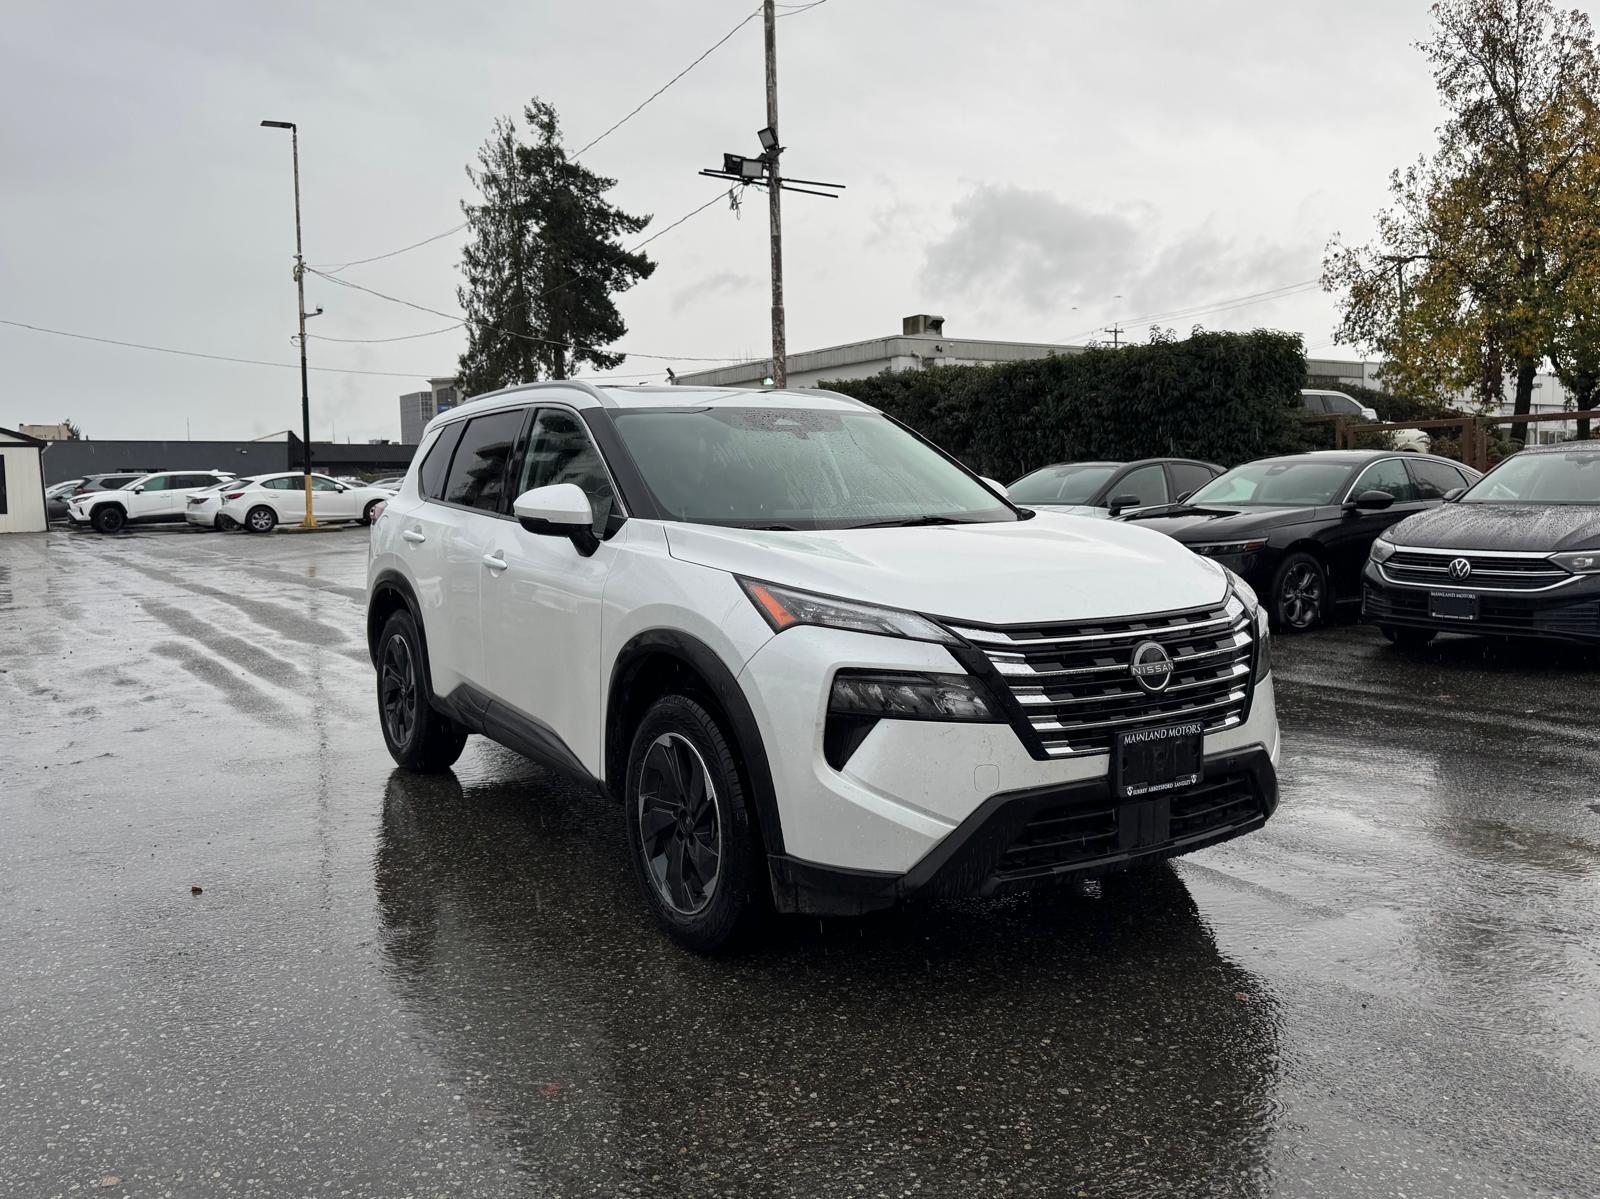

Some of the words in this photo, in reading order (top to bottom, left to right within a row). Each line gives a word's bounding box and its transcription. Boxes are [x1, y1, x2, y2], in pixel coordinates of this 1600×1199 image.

[1132, 662, 1174, 676] NISSAN
[1123, 729, 1167, 745] MAINLAND
[1168, 723, 1201, 738] MOTORS
